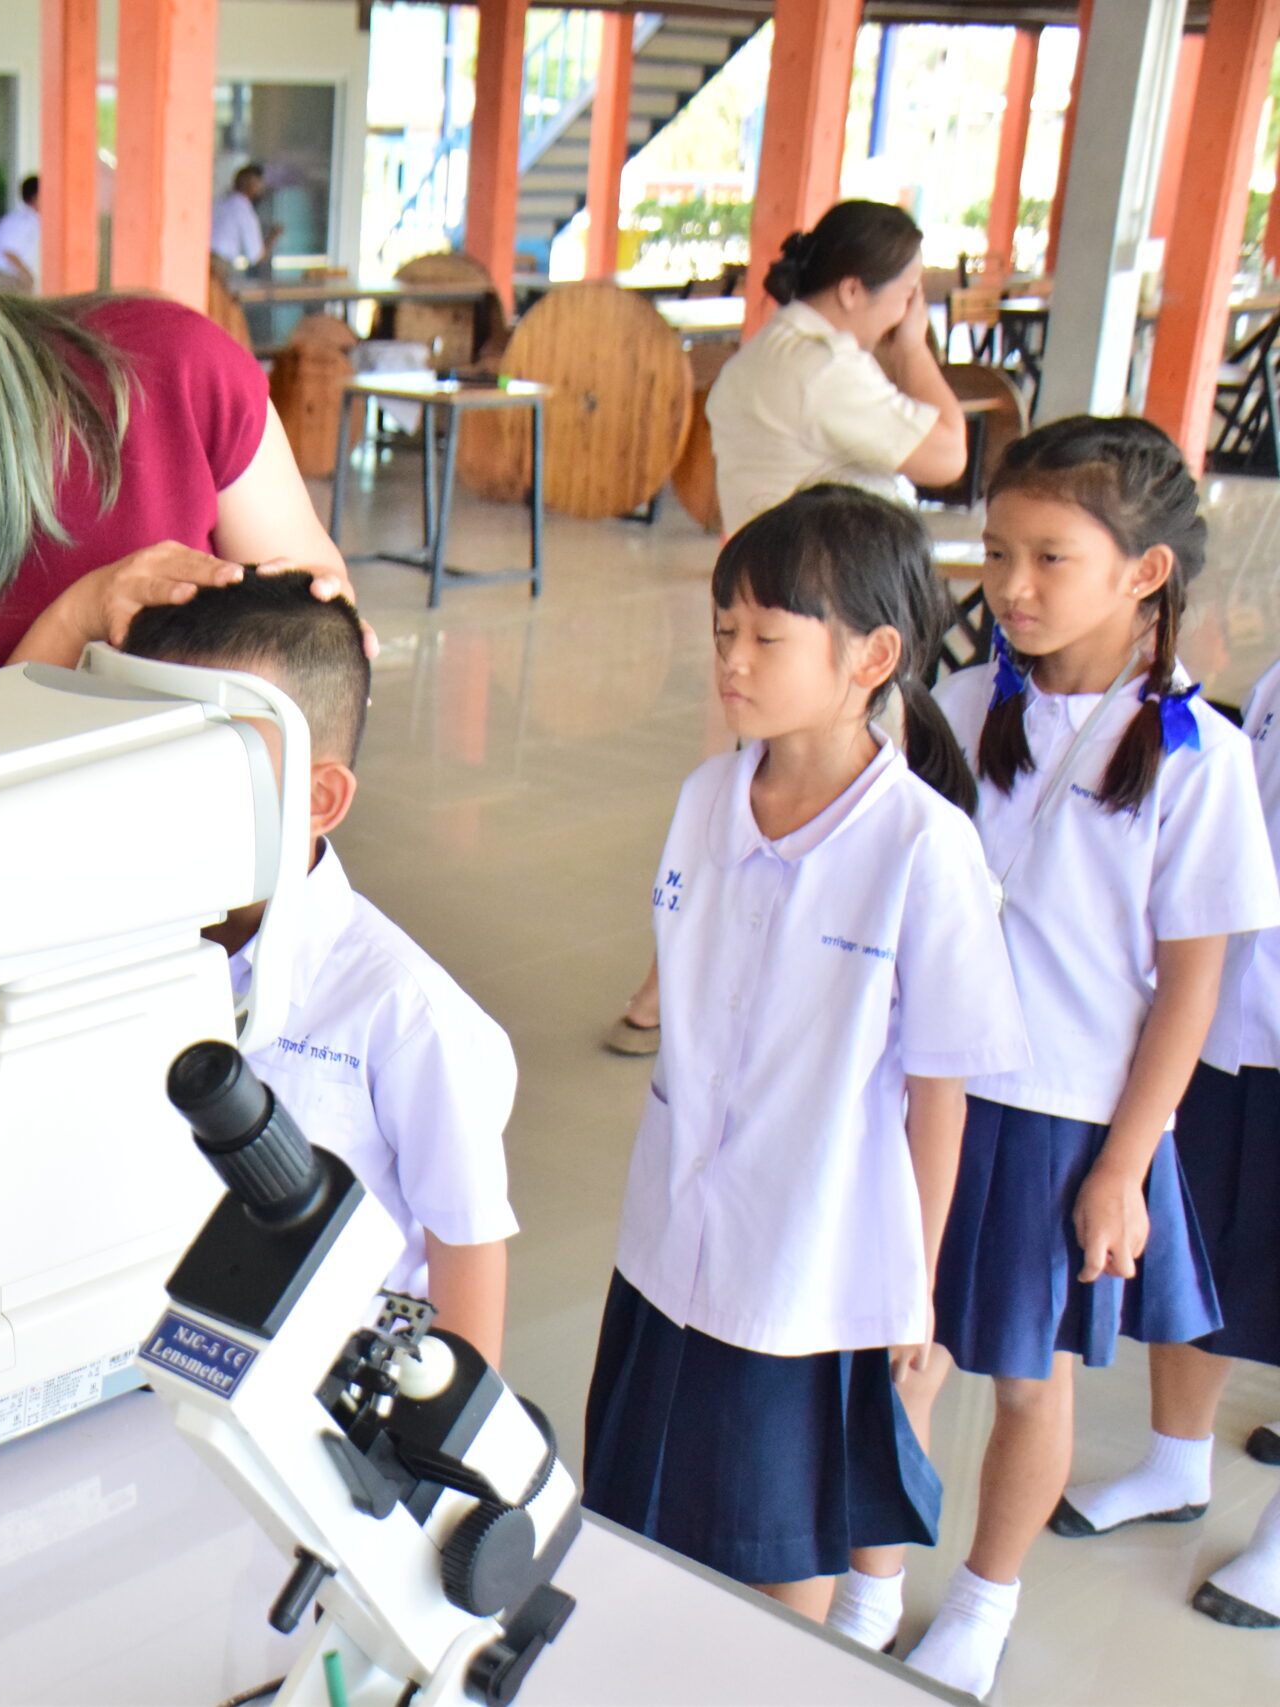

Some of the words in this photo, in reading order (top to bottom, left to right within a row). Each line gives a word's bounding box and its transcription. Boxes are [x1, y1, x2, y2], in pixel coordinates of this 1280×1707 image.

[271, 1033, 310, 1054] าฤทธิ์
[173, 1325, 220, 1358] NJC-5
[150, 1337, 234, 1389] Lensmeter
